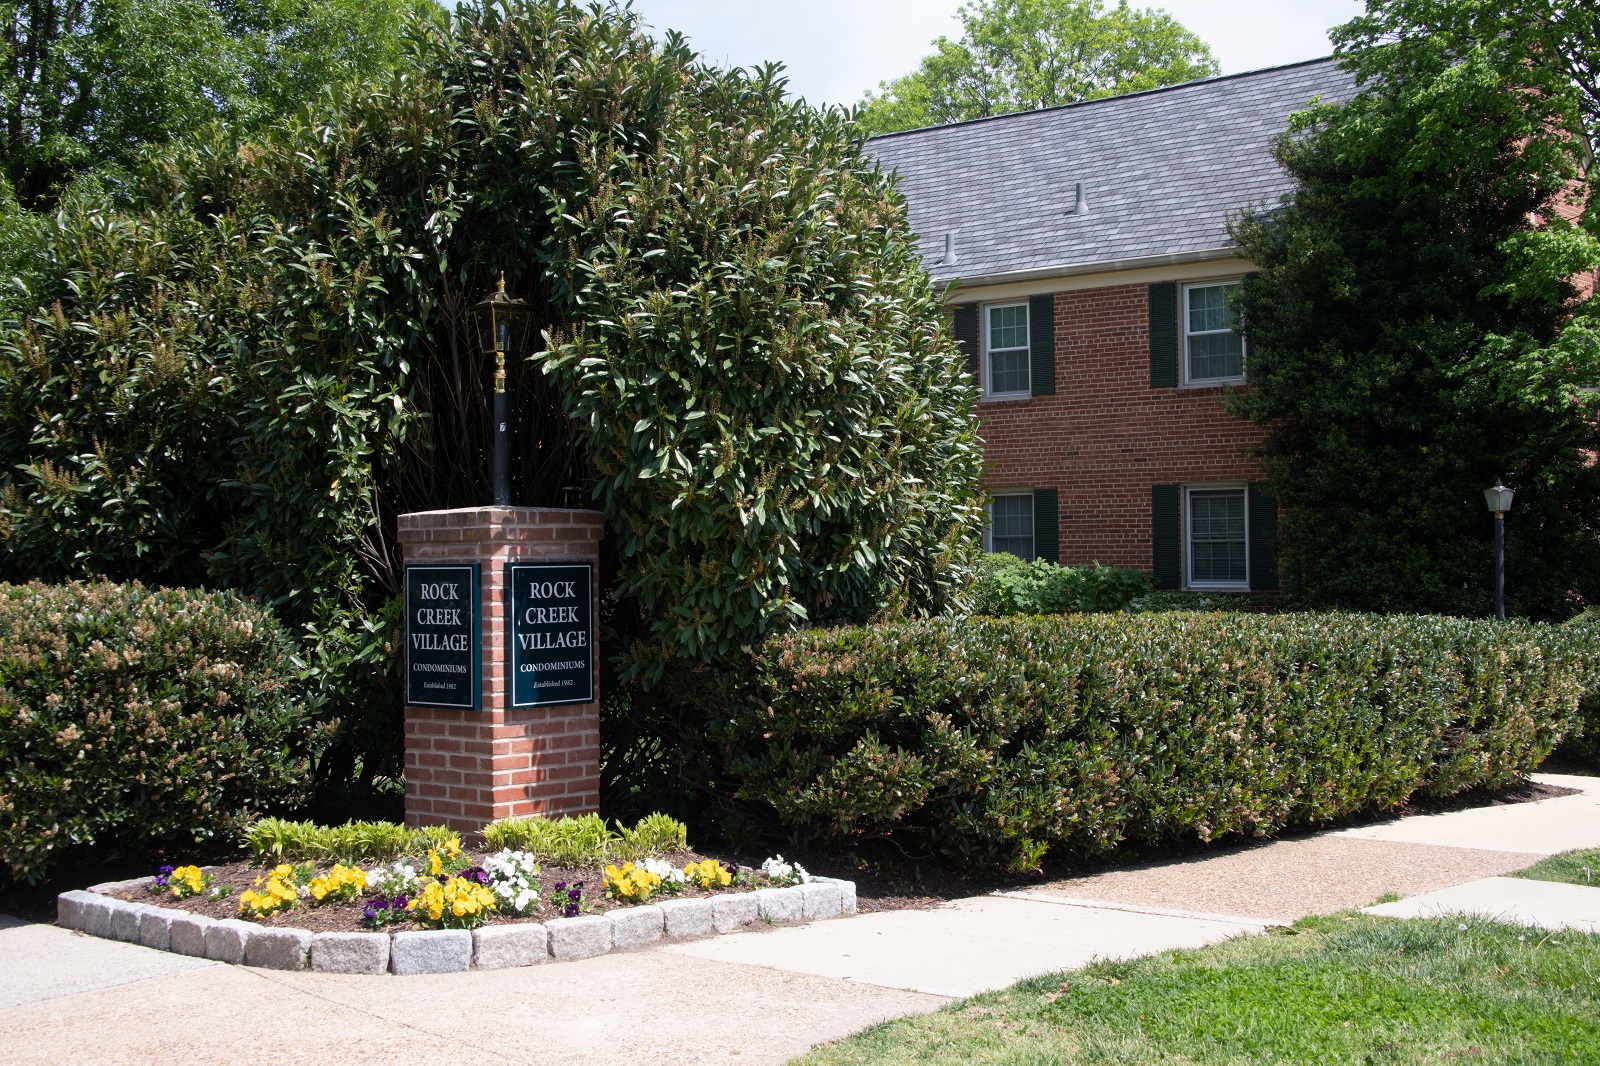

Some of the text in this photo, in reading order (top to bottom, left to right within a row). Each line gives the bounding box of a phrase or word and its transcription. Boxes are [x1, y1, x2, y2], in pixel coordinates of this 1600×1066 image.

[421, 583, 459, 600] ROCK
[530, 581, 576, 599] ROCK
[417, 608, 462, 625] CREEK
[526, 606, 579, 624] CREEK
[412, 634, 468, 651] VILLAGE
[519, 631, 587, 650] VILLAGE
[413, 662, 467, 673] CONDOMINIUMS
[520, 660, 585, 672] CONDOMINIUMS
[533, 680, 560, 688] Established
